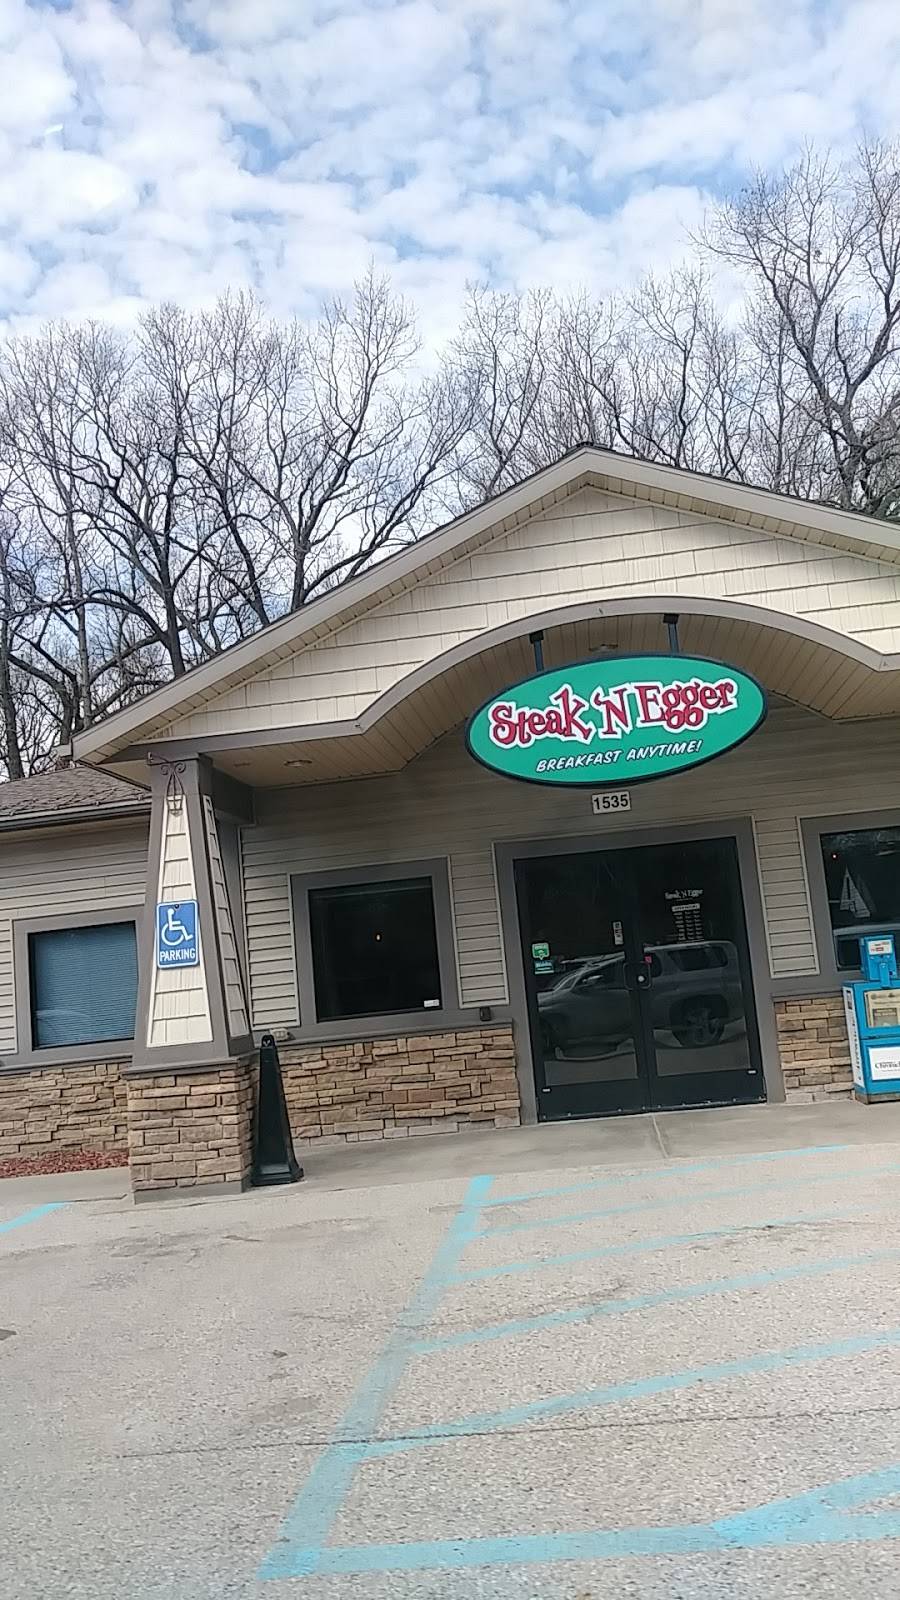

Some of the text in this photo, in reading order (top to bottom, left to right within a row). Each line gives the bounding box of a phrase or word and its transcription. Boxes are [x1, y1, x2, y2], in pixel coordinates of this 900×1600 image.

[490, 686, 594, 746] Steak
[633, 679, 735, 730] Egger
[536, 740, 703, 772] BREAKFAST ANYTIME!
[593, 793, 629, 810] 1535
[159, 947, 196, 962] PARKING
